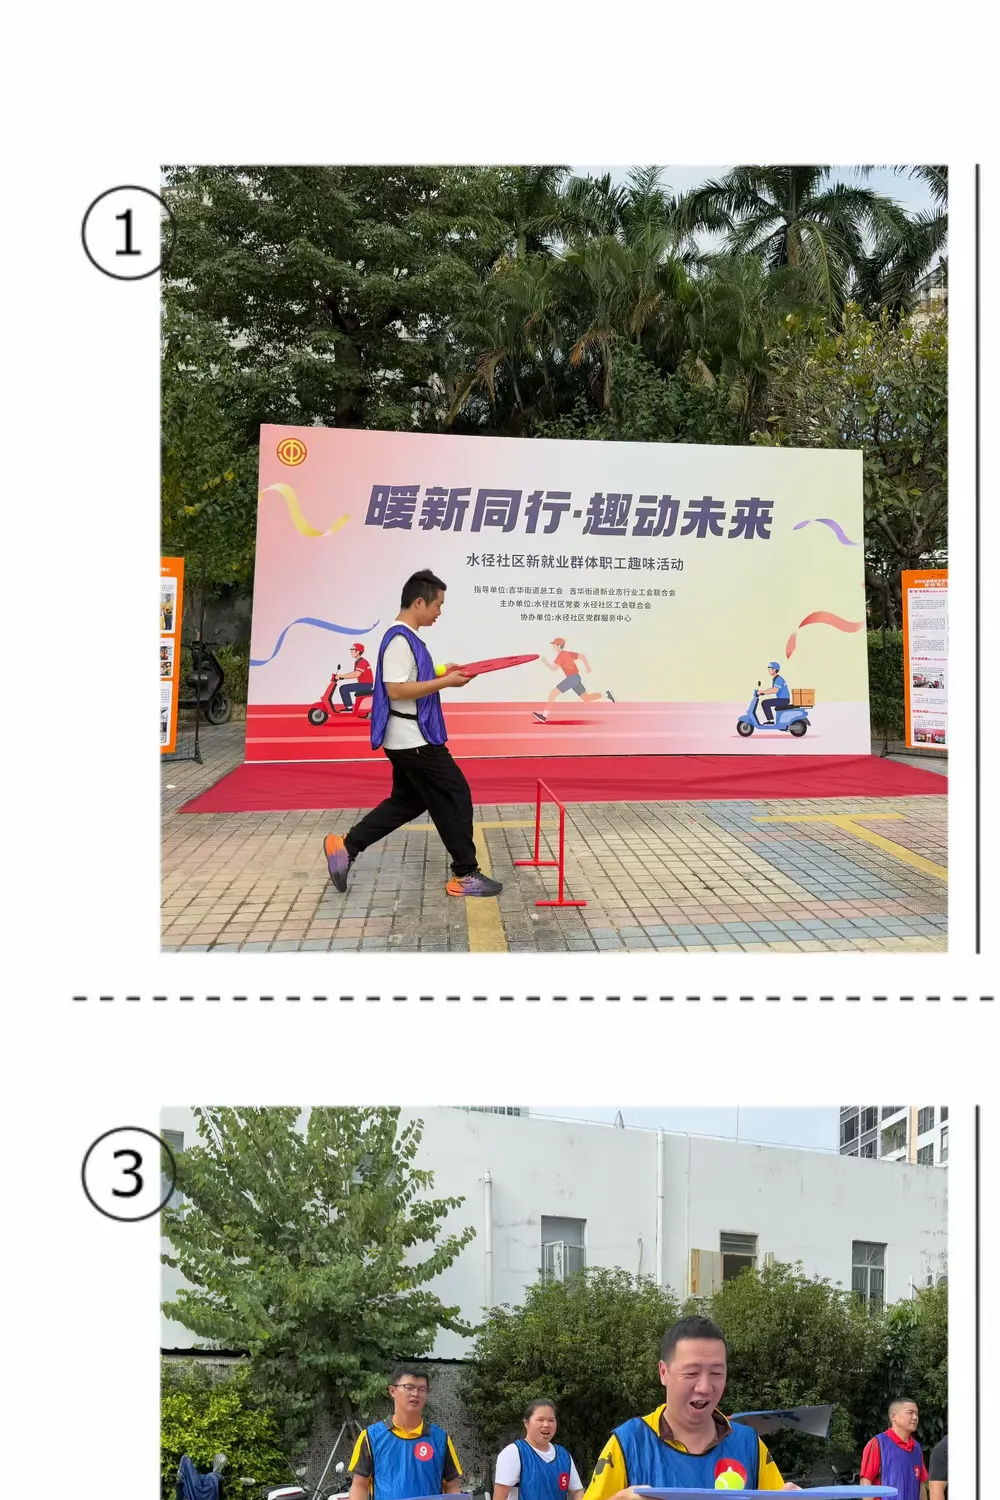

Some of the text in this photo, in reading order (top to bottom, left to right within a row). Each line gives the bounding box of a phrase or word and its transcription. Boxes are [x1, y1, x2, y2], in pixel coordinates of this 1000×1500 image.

[364, 484, 775, 540] 暖新同行·趣动未来
[466, 552, 684, 572] 水径社区新就业群体职工趣味活动
[419, 1446, 428, 1457] 9
